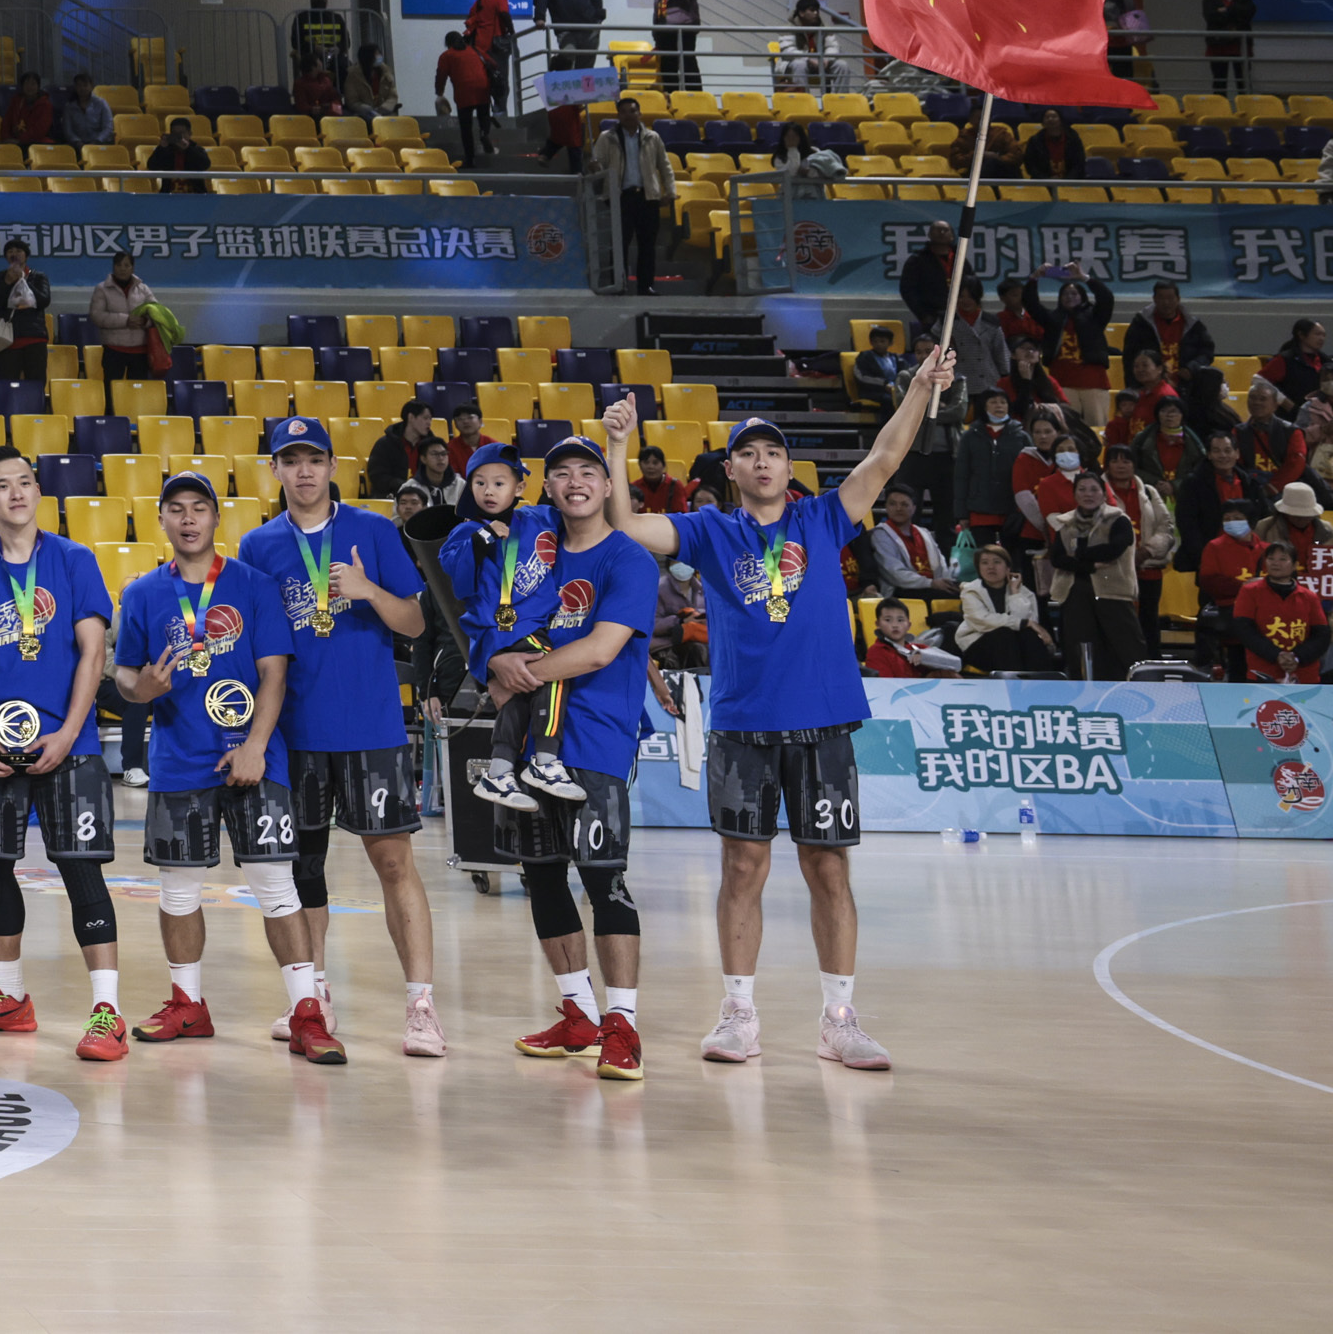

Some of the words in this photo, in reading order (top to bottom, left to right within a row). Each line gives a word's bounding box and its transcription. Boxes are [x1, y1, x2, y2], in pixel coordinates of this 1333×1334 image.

[1265, 616, 1307, 642] 大岗
[945, 708, 1122, 751] 我的联赛
[920, 749, 1119, 791] 我的区BA
[371, 787, 389, 820] 9
[814, 798, 855, 832] 30
[76, 810, 97, 842] 8
[257, 813, 294, 845] 28
[573, 817, 604, 851] 10
